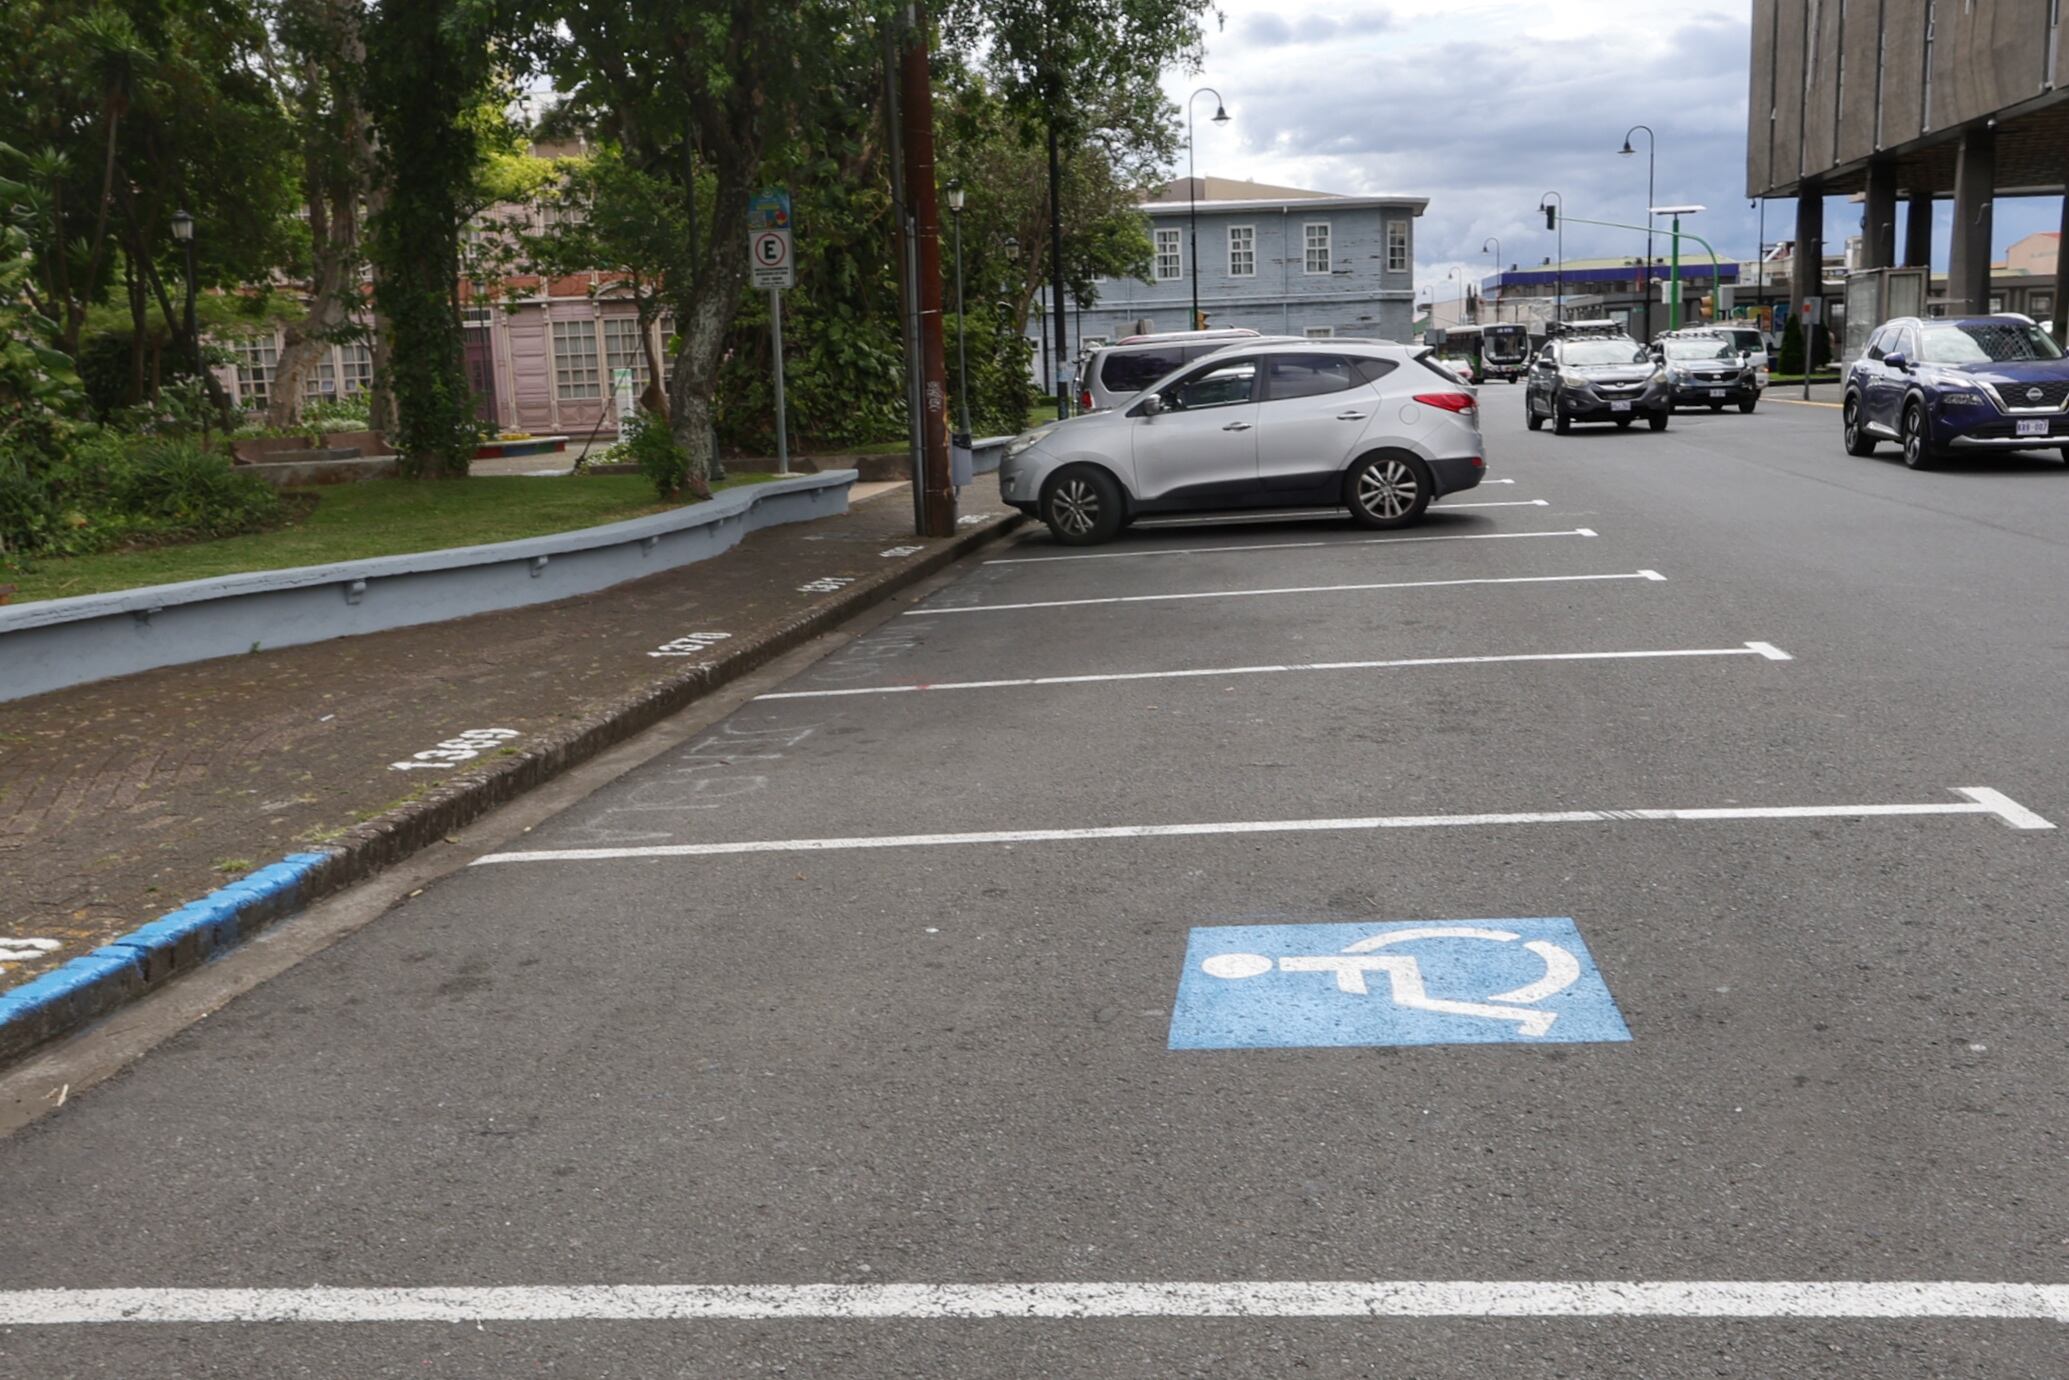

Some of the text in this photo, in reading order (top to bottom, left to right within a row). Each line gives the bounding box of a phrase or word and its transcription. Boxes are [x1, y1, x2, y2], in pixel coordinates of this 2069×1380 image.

[764, 240, 776, 259] E
[647, 632, 732, 657] 1370
[390, 728, 520, 770] 1369
